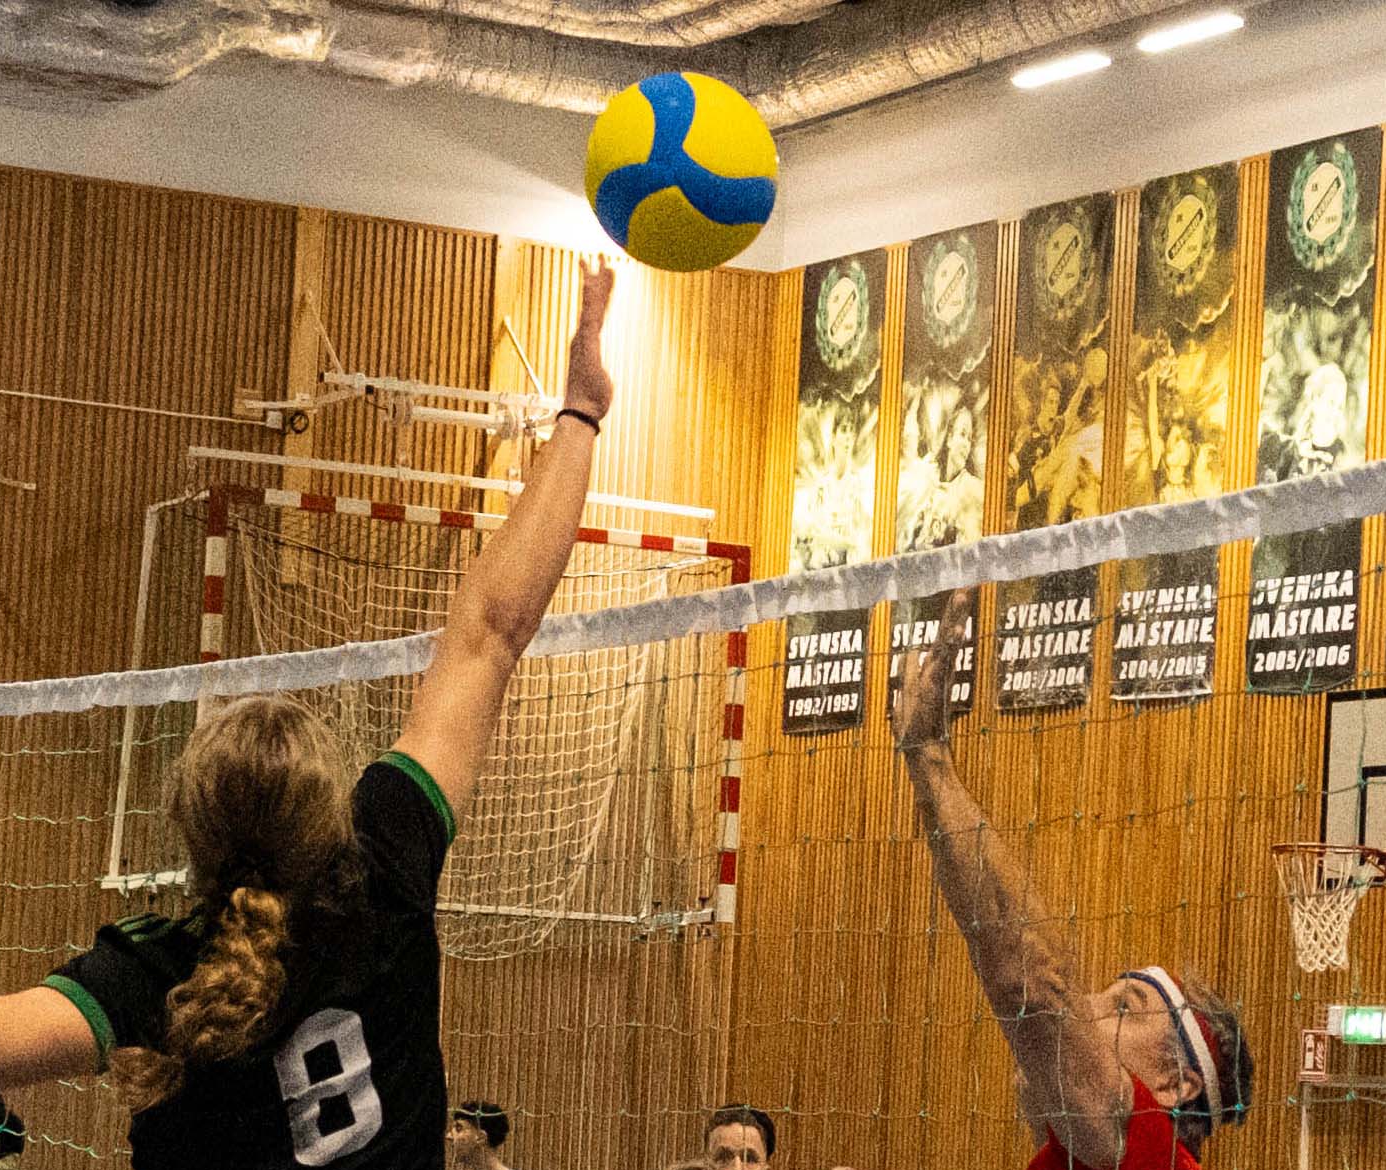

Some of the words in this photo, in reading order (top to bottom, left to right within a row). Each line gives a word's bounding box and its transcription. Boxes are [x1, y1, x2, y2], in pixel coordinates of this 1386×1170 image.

[1119, 583, 1213, 617] SVENSKA
[1252, 569, 1354, 606] SVENSKA
[1004, 597, 1091, 630] SVENSKA
[1248, 603, 1356, 640] MÄSTARE
[788, 628, 863, 660] SVENSKA
[1114, 616, 1215, 649] MÄSTARE
[786, 658, 862, 689] MÄSTARE
[1253, 644, 1351, 673] 2005/2006
[788, 692, 859, 717] 1992/1993
[273, 1007, 383, 1167] 8
